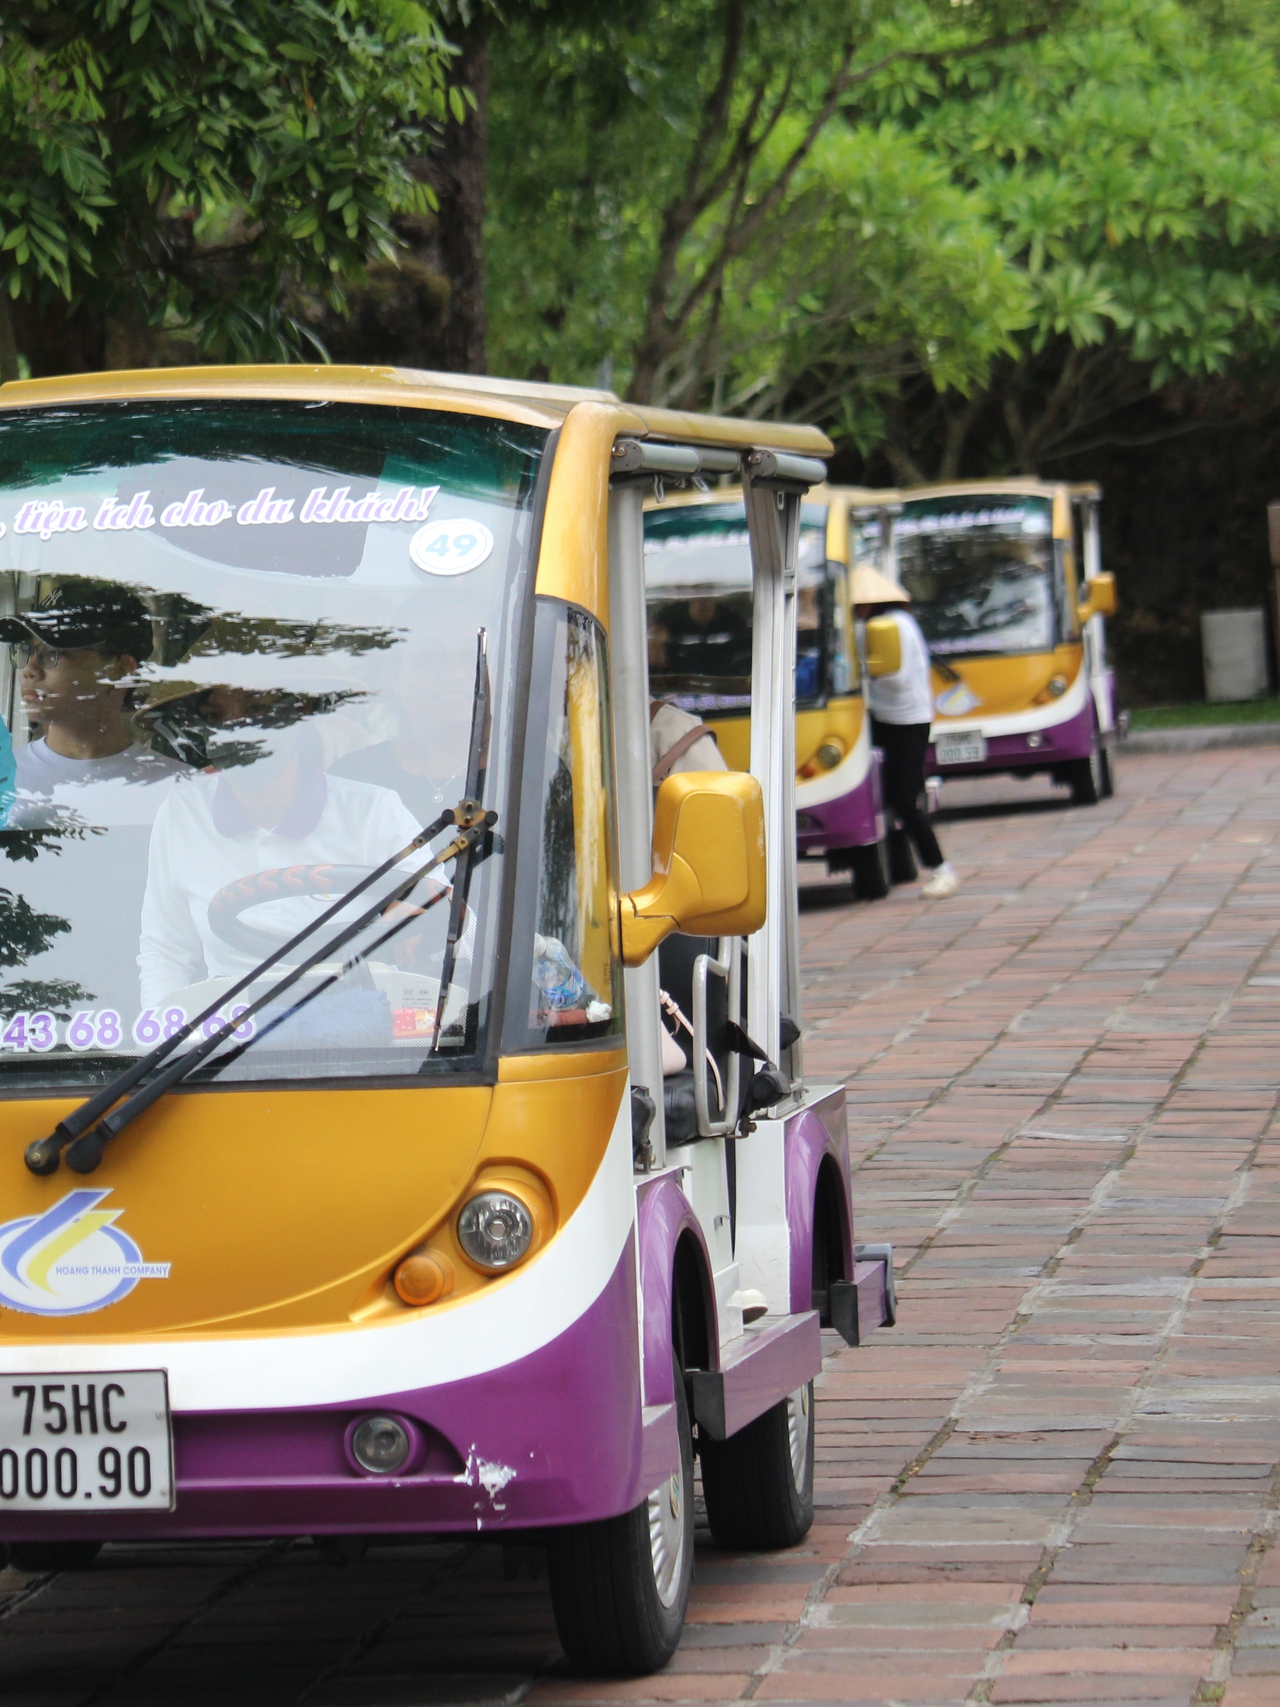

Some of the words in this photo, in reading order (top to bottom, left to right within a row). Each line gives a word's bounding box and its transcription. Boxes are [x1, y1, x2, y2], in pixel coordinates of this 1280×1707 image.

[13, 499, 88, 540] tiện
[160, 488, 235, 527] cho
[237, 486, 295, 525] du
[300, 486, 440, 523] khách!
[425, 533, 478, 557] 49
[65, 1008, 122, 1050] 68
[132, 1006, 187, 1046] 68
[56, 1266, 88, 1275] HOANG
[91, 1266, 120, 1275] THANH
[123, 1266, 167, 1275] COMPANY
[12, 1383, 127, 1435] 75HC
